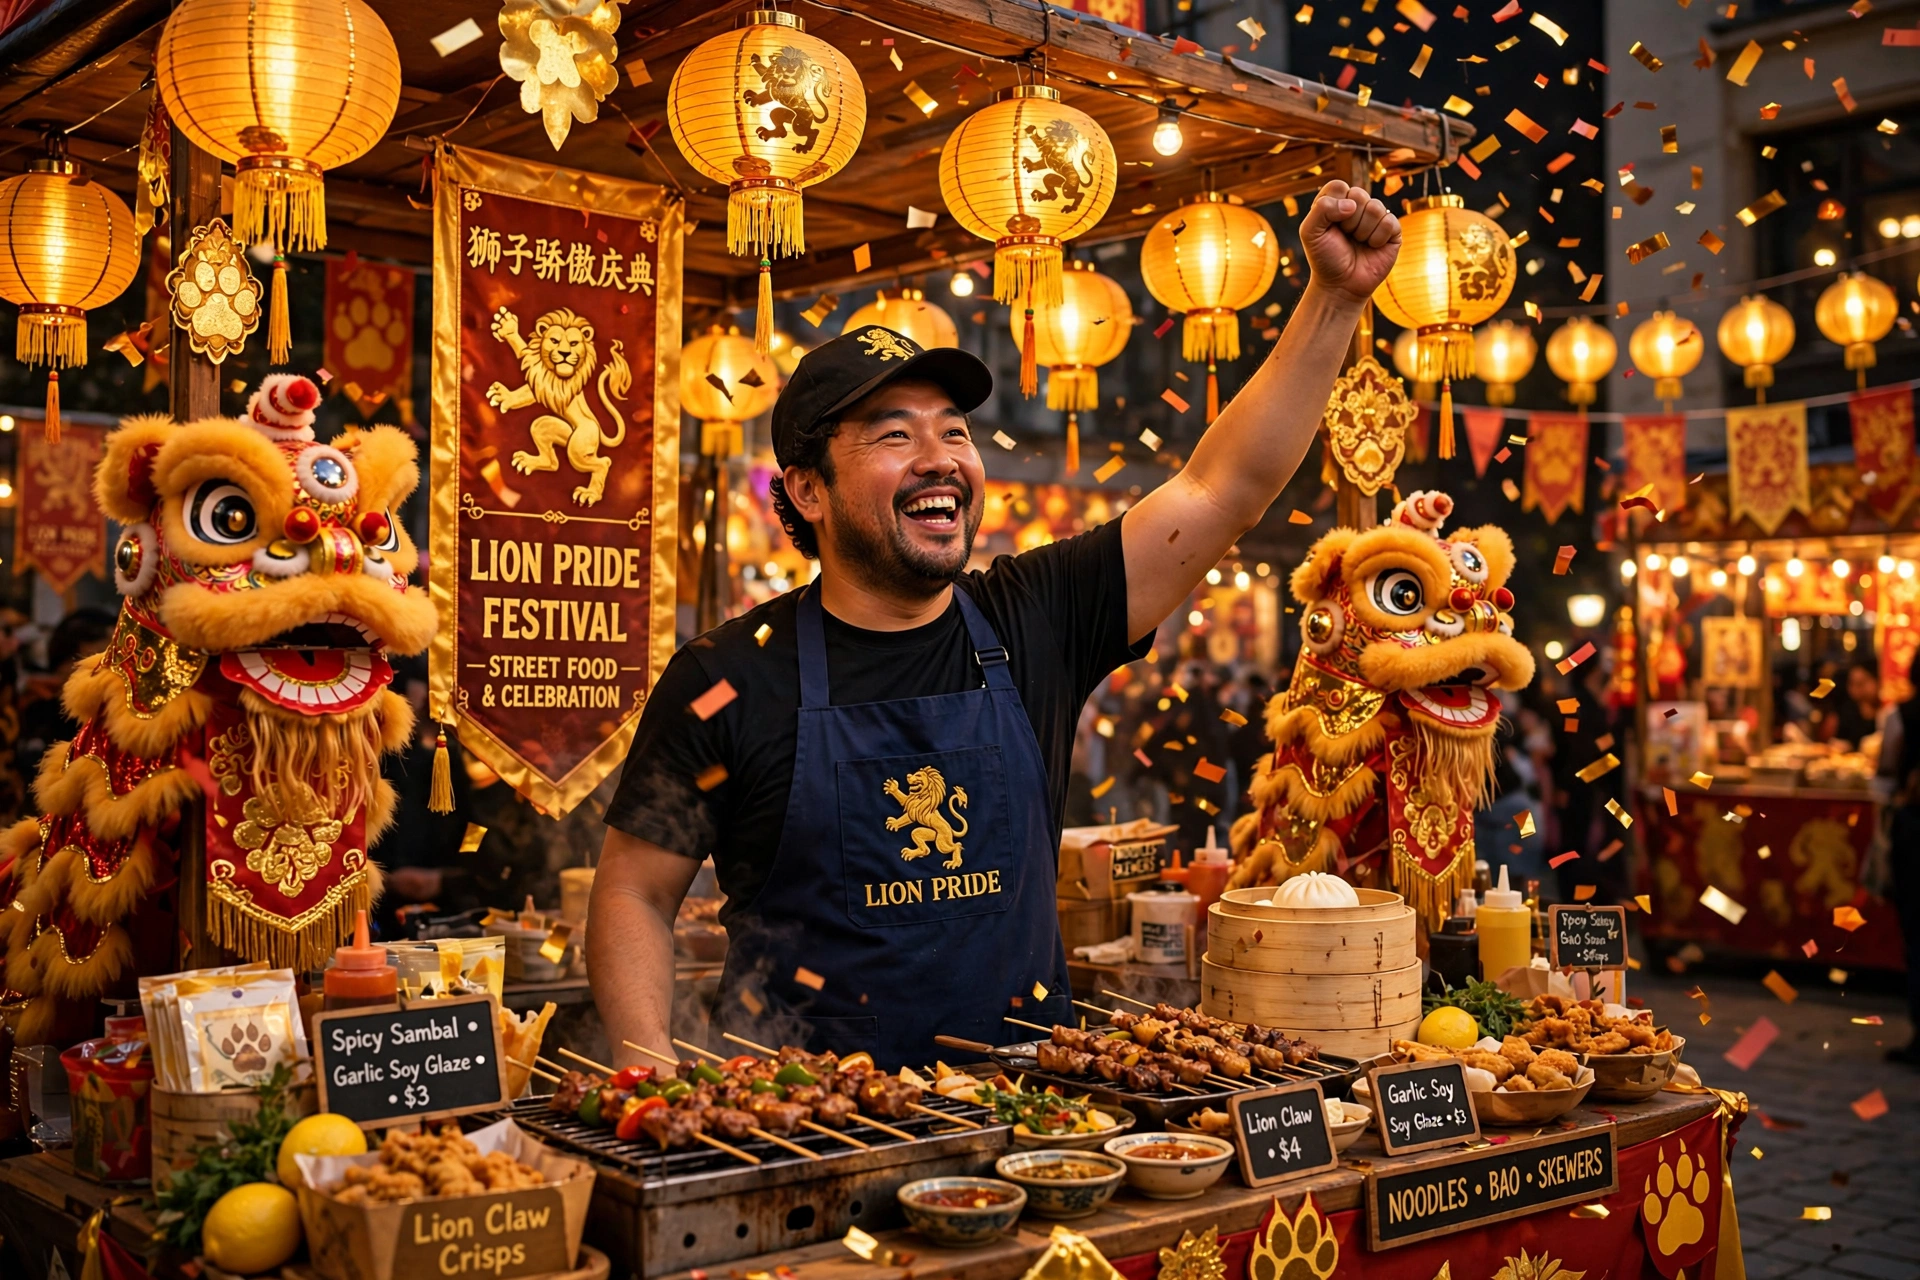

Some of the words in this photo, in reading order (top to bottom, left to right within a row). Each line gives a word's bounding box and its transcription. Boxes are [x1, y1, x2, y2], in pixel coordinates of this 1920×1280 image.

[466, 225, 655, 297] 狮子骄傲庆典
[470, 538, 543, 584] LION
[552, 543, 640, 589] PRIDE
[483, 597, 628, 643] FESTIVAL
[489, 655, 561, 679] STREET
[567, 657, 618, 680] FOOD
[482, 684, 496, 707] &
[501, 684, 621, 709] CELEBRATION
[864, 880, 923, 907] LION
[931, 870, 1002, 901] PRIDE
[332, 1028, 384, 1056] Spicy
[390, 1015, 459, 1045] Sambal
[333, 1062, 385, 1087] Garlic
[389, 1059, 420, 1084] Soy
[424, 1053, 472, 1075] Glaze
[404, 1085, 430, 1109] $3
[1388, 1081, 1428, 1104] Garlic
[1430, 1078, 1454, 1103] Soy
[1246, 1113, 1278, 1135] Lion
[1280, 1105, 1313, 1127] Claw
[1389, 1116, 1411, 1141] Soy
[1278, 1135, 1302, 1163] $4
[1388, 1177, 1468, 1224] NOODLES
[1489, 1166, 1520, 1201] BAO
[1538, 1147, 1603, 1189] SKEWERS
[413, 1212, 474, 1245] Lion
[485, 1201, 551, 1235] Claw
[438, 1242, 526, 1276] Crisps
